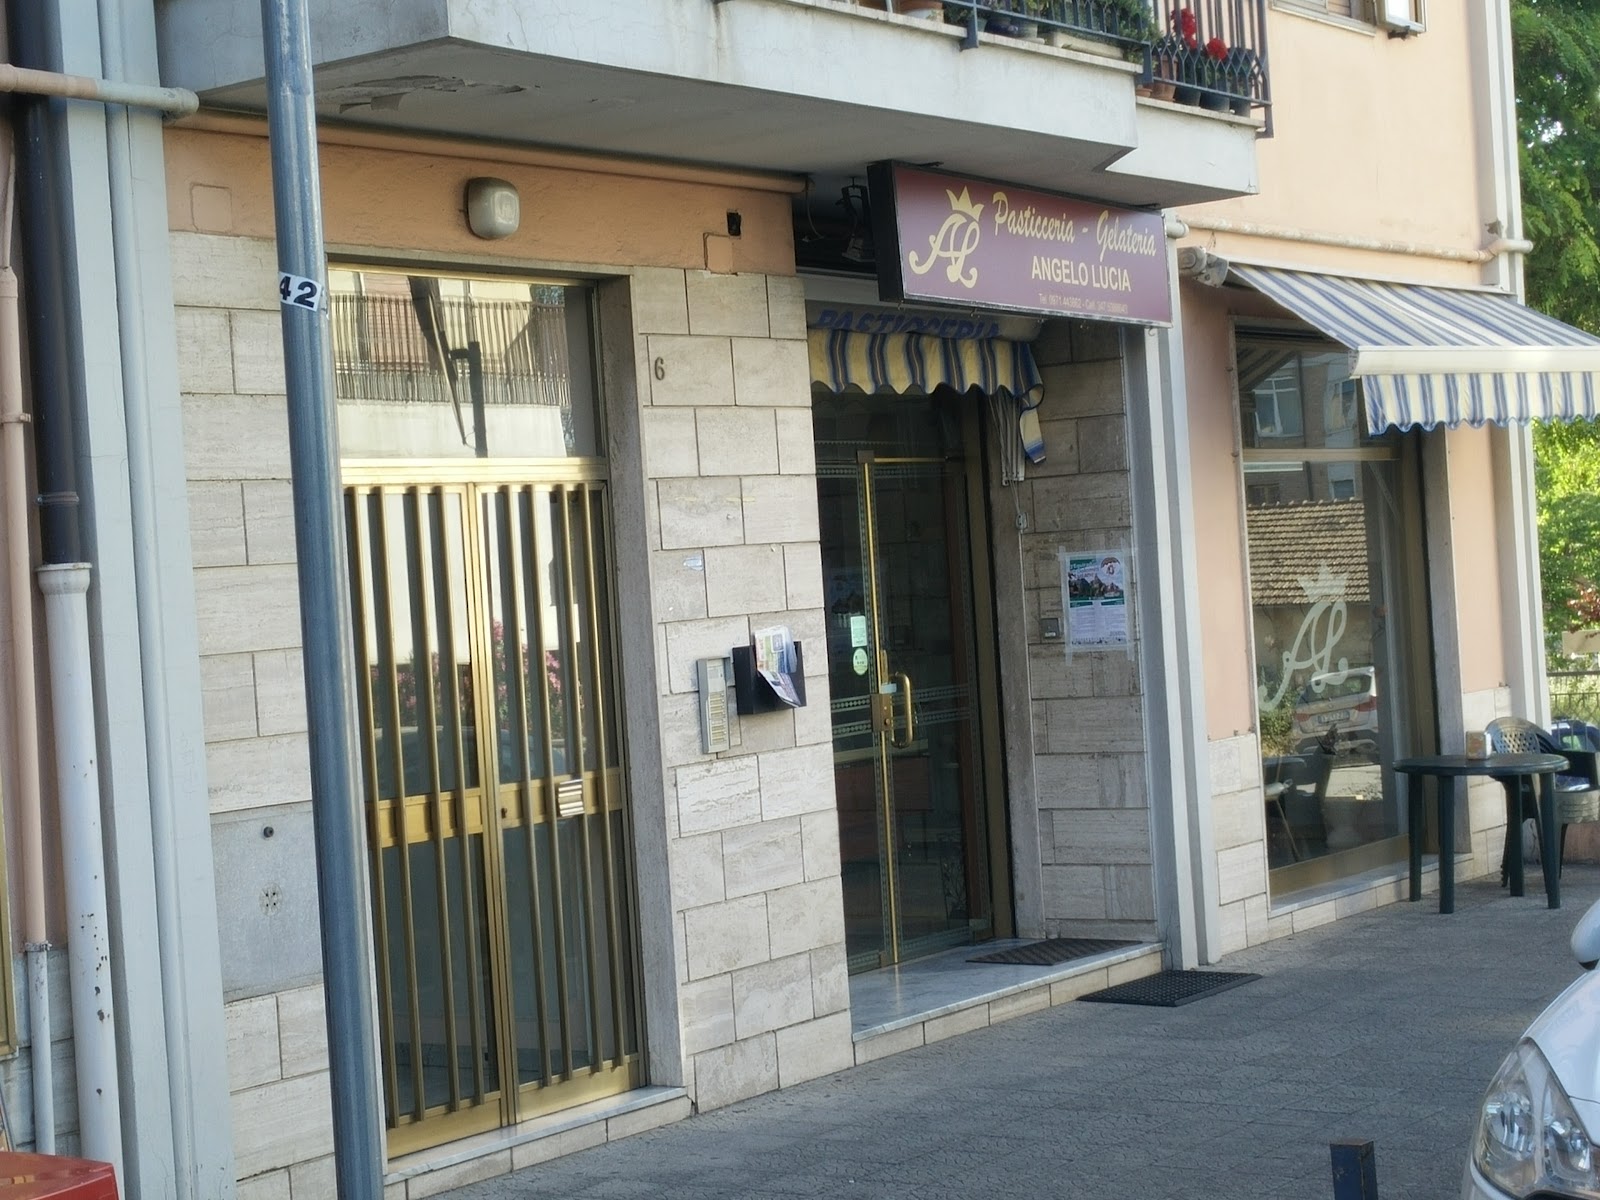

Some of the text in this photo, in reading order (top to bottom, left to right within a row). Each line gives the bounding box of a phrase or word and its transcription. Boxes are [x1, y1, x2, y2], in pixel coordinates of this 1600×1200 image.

[992, 191, 1076, 244] Pasticceria
[1096, 209, 1157, 263] Gelateria
[1031, 255, 1132, 292] ANGELO LUCIA
[279, 275, 318, 309] 42
[653, 356, 666, 381] 6
